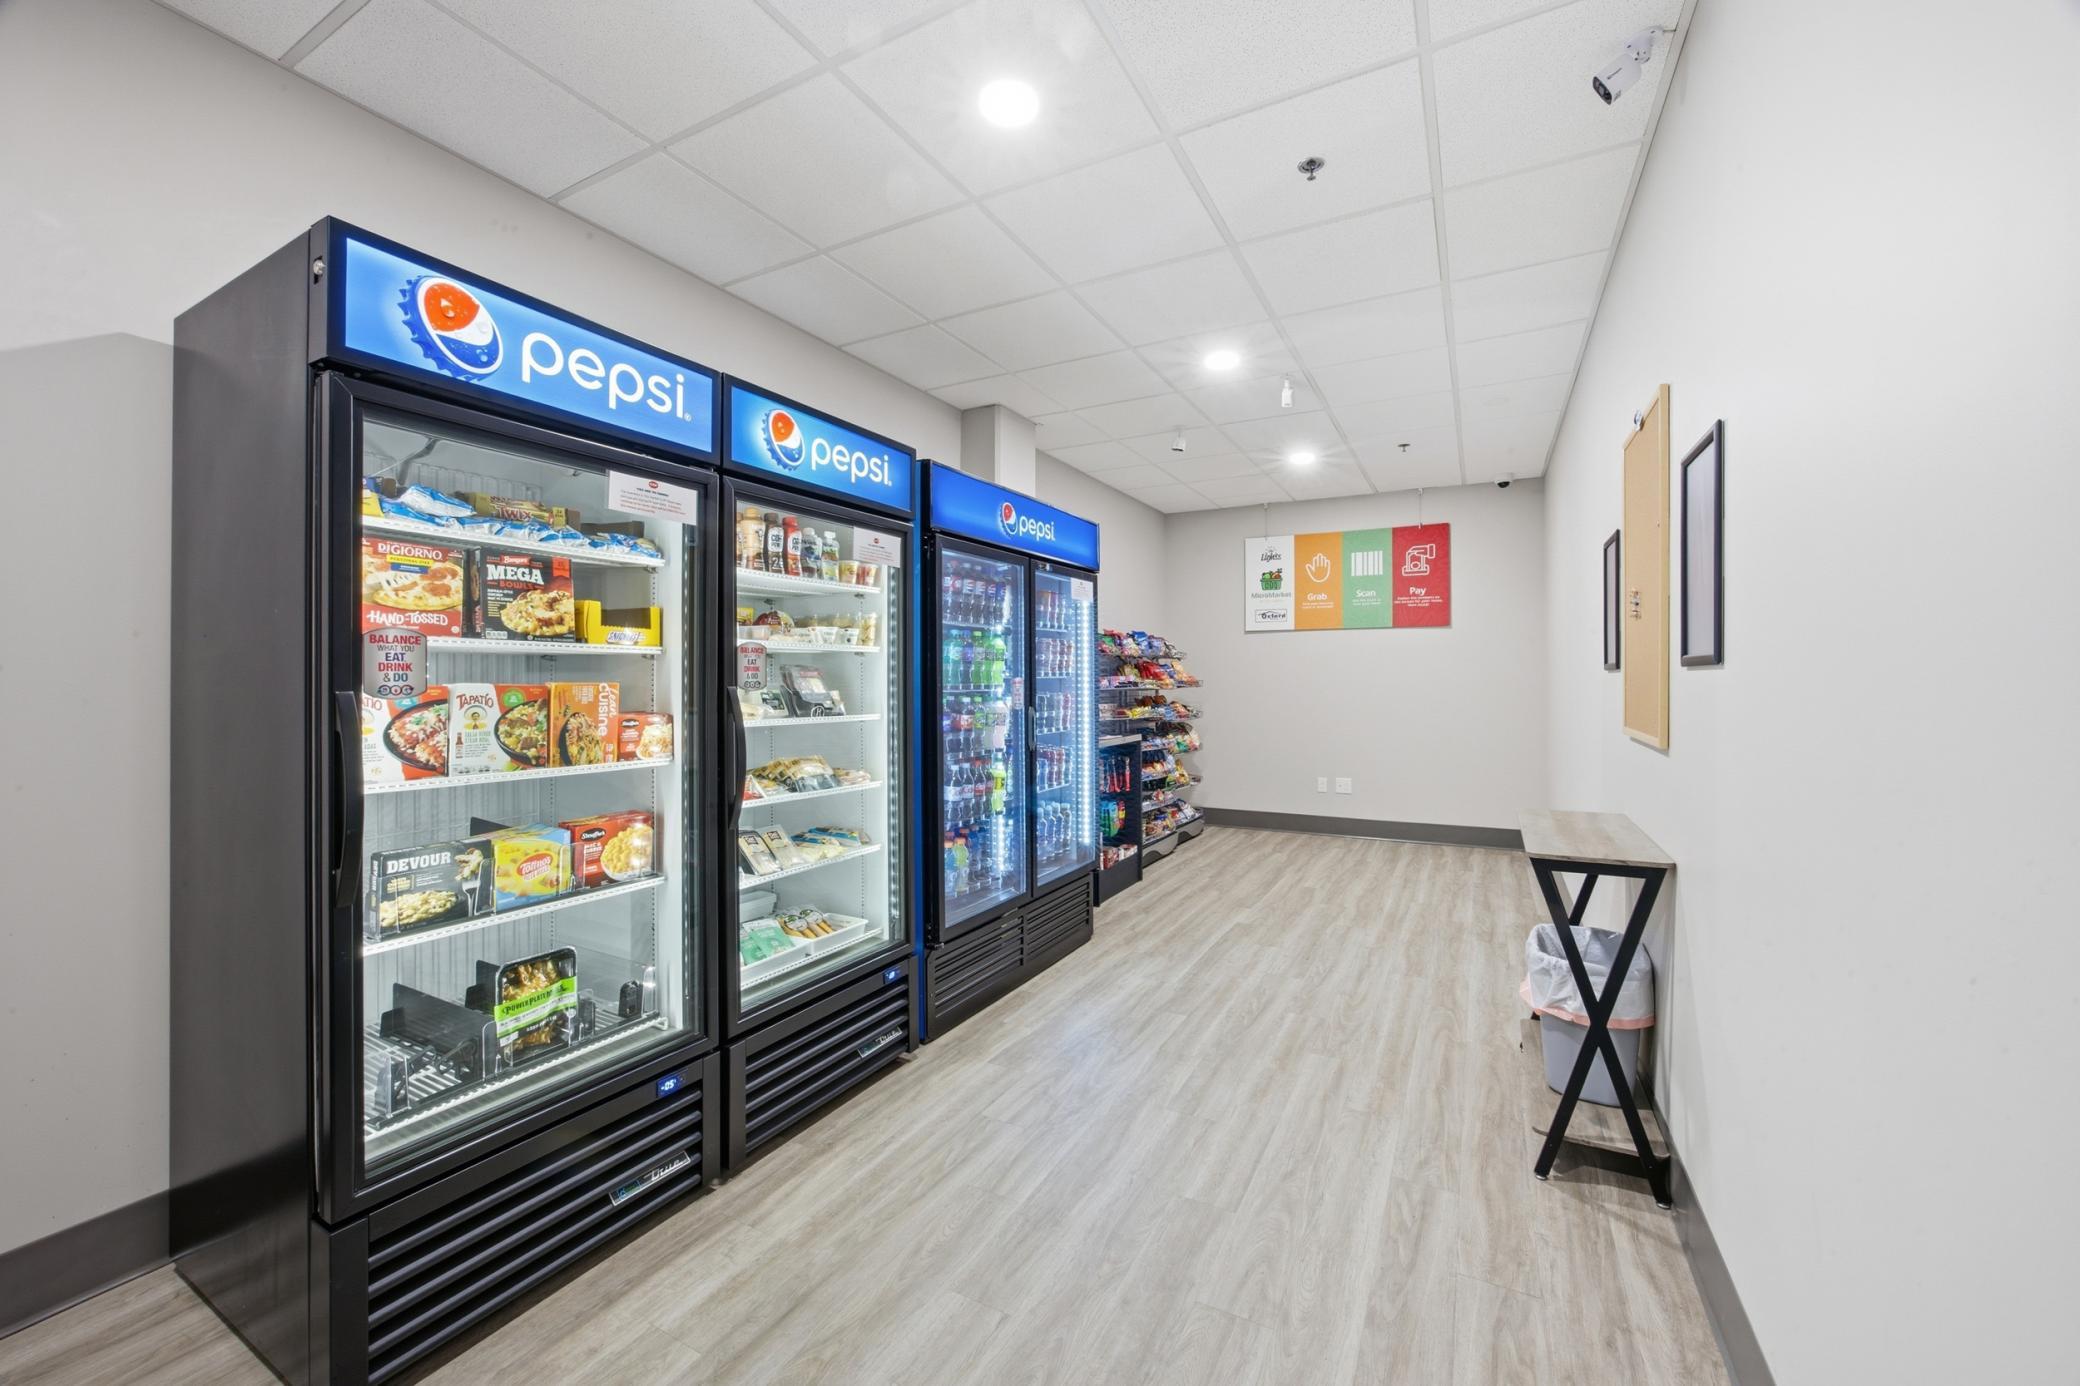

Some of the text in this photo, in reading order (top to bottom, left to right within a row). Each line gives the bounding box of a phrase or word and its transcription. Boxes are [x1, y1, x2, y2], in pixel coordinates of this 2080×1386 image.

[521, 332, 684, 419] pepsi
[811, 437, 889, 485] pepsi
[1019, 515, 1055, 541] pepsi
[486, 564, 544, 585] MEGA
[1307, 592, 1328, 600] Grab
[1356, 589, 1376, 597] Scan
[1409, 586, 1426, 596] Pay
[367, 610, 449, 626] HAND-TOSSED
[369, 634, 421, 645] BALANCE
[385, 652, 405, 662] EAT
[377, 662, 413, 672] DRINK
[383, 672, 408, 682] & DO
[386, 851, 452, 874] DEVOUR
